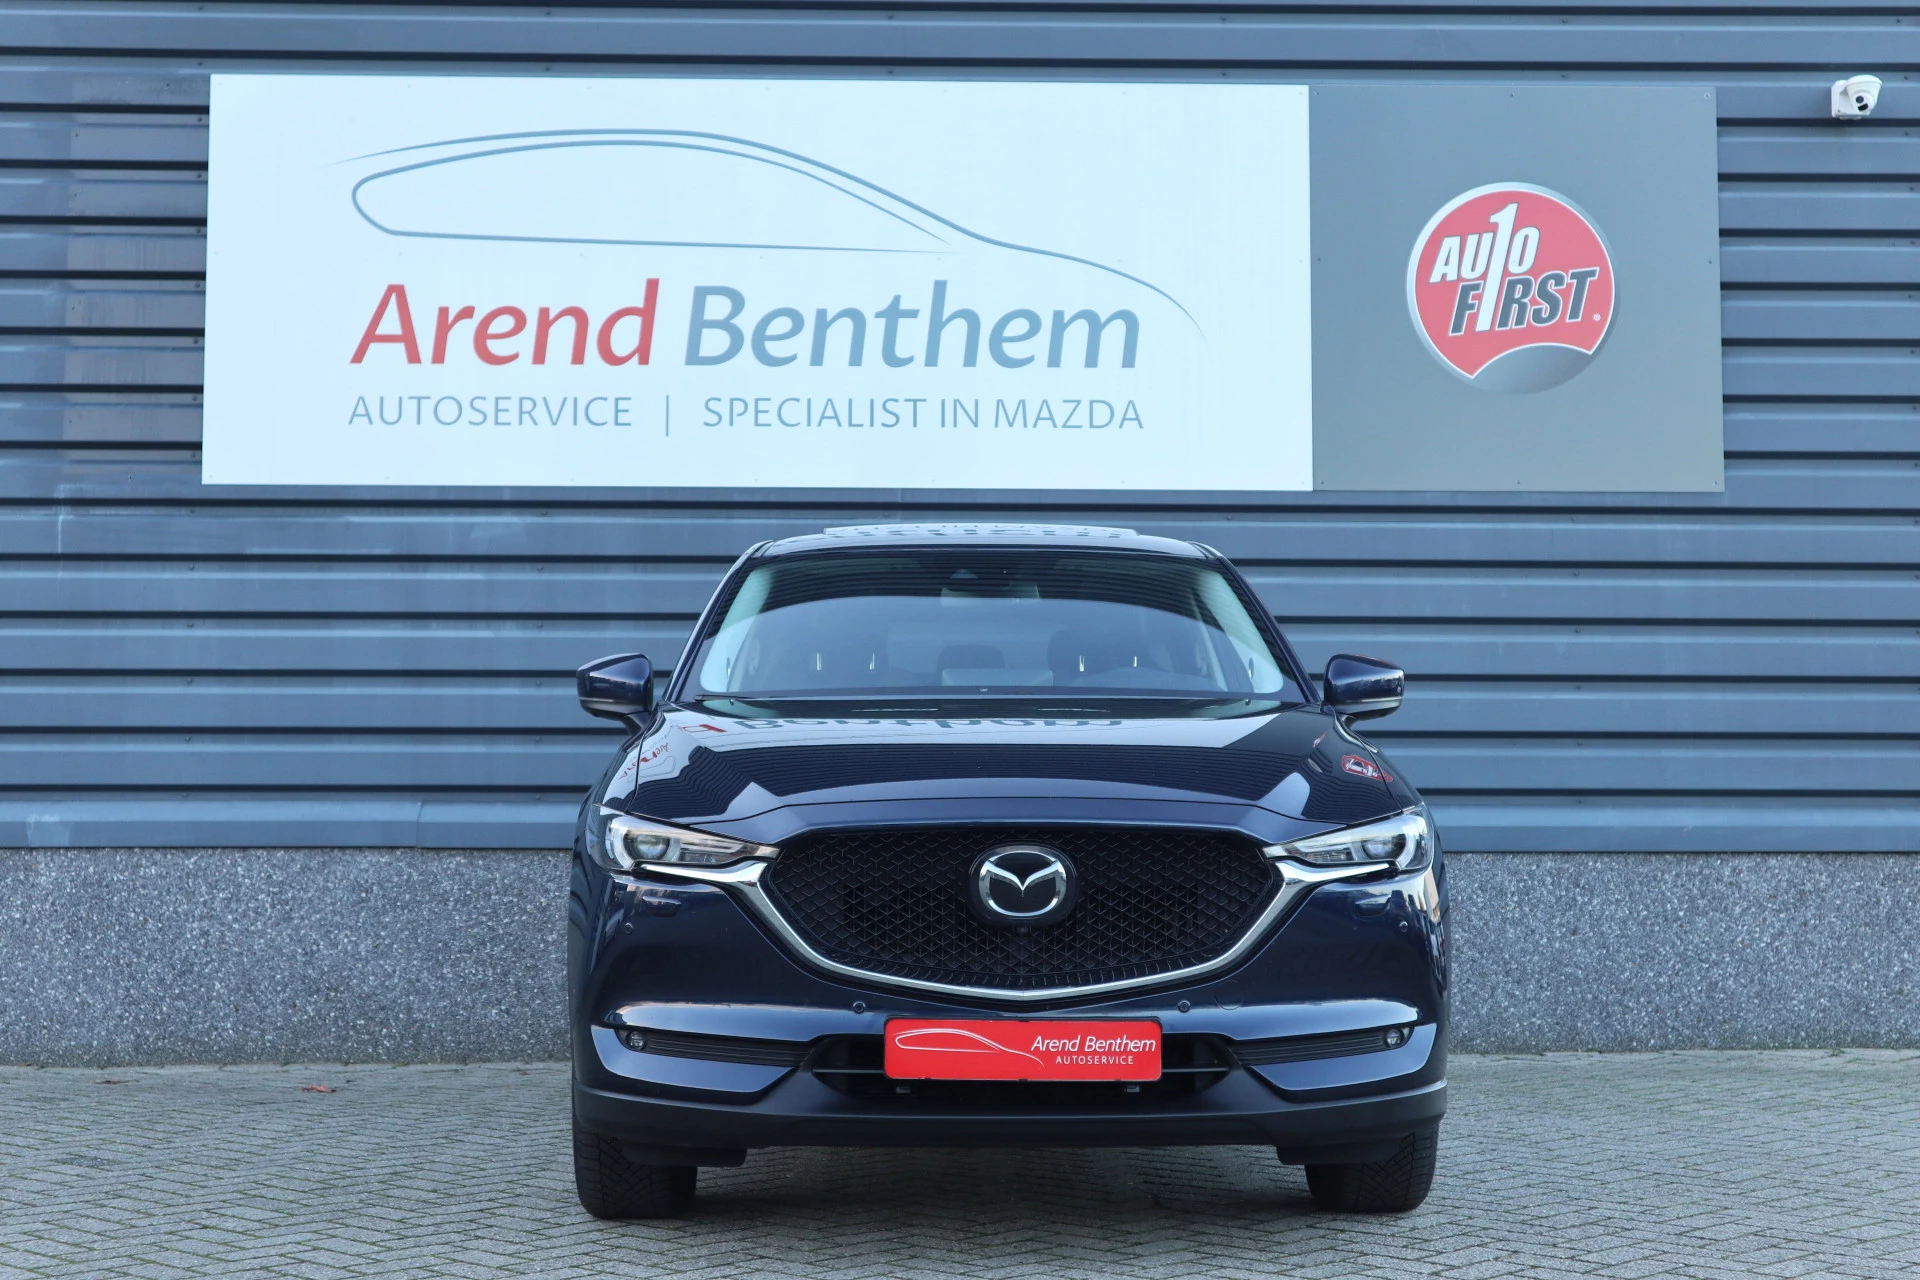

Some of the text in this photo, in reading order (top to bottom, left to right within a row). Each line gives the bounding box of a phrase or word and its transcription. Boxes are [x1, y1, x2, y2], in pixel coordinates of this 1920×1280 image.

[349, 278, 1140, 369] Arend Benthem
[348, 395, 1145, 430] AUTOSERVICE SPECIALIST IN MAZDA
[1031, 1034, 1156, 1052] Arend Benthem
[1055, 1055, 1134, 1065] AUTOSERVICE
